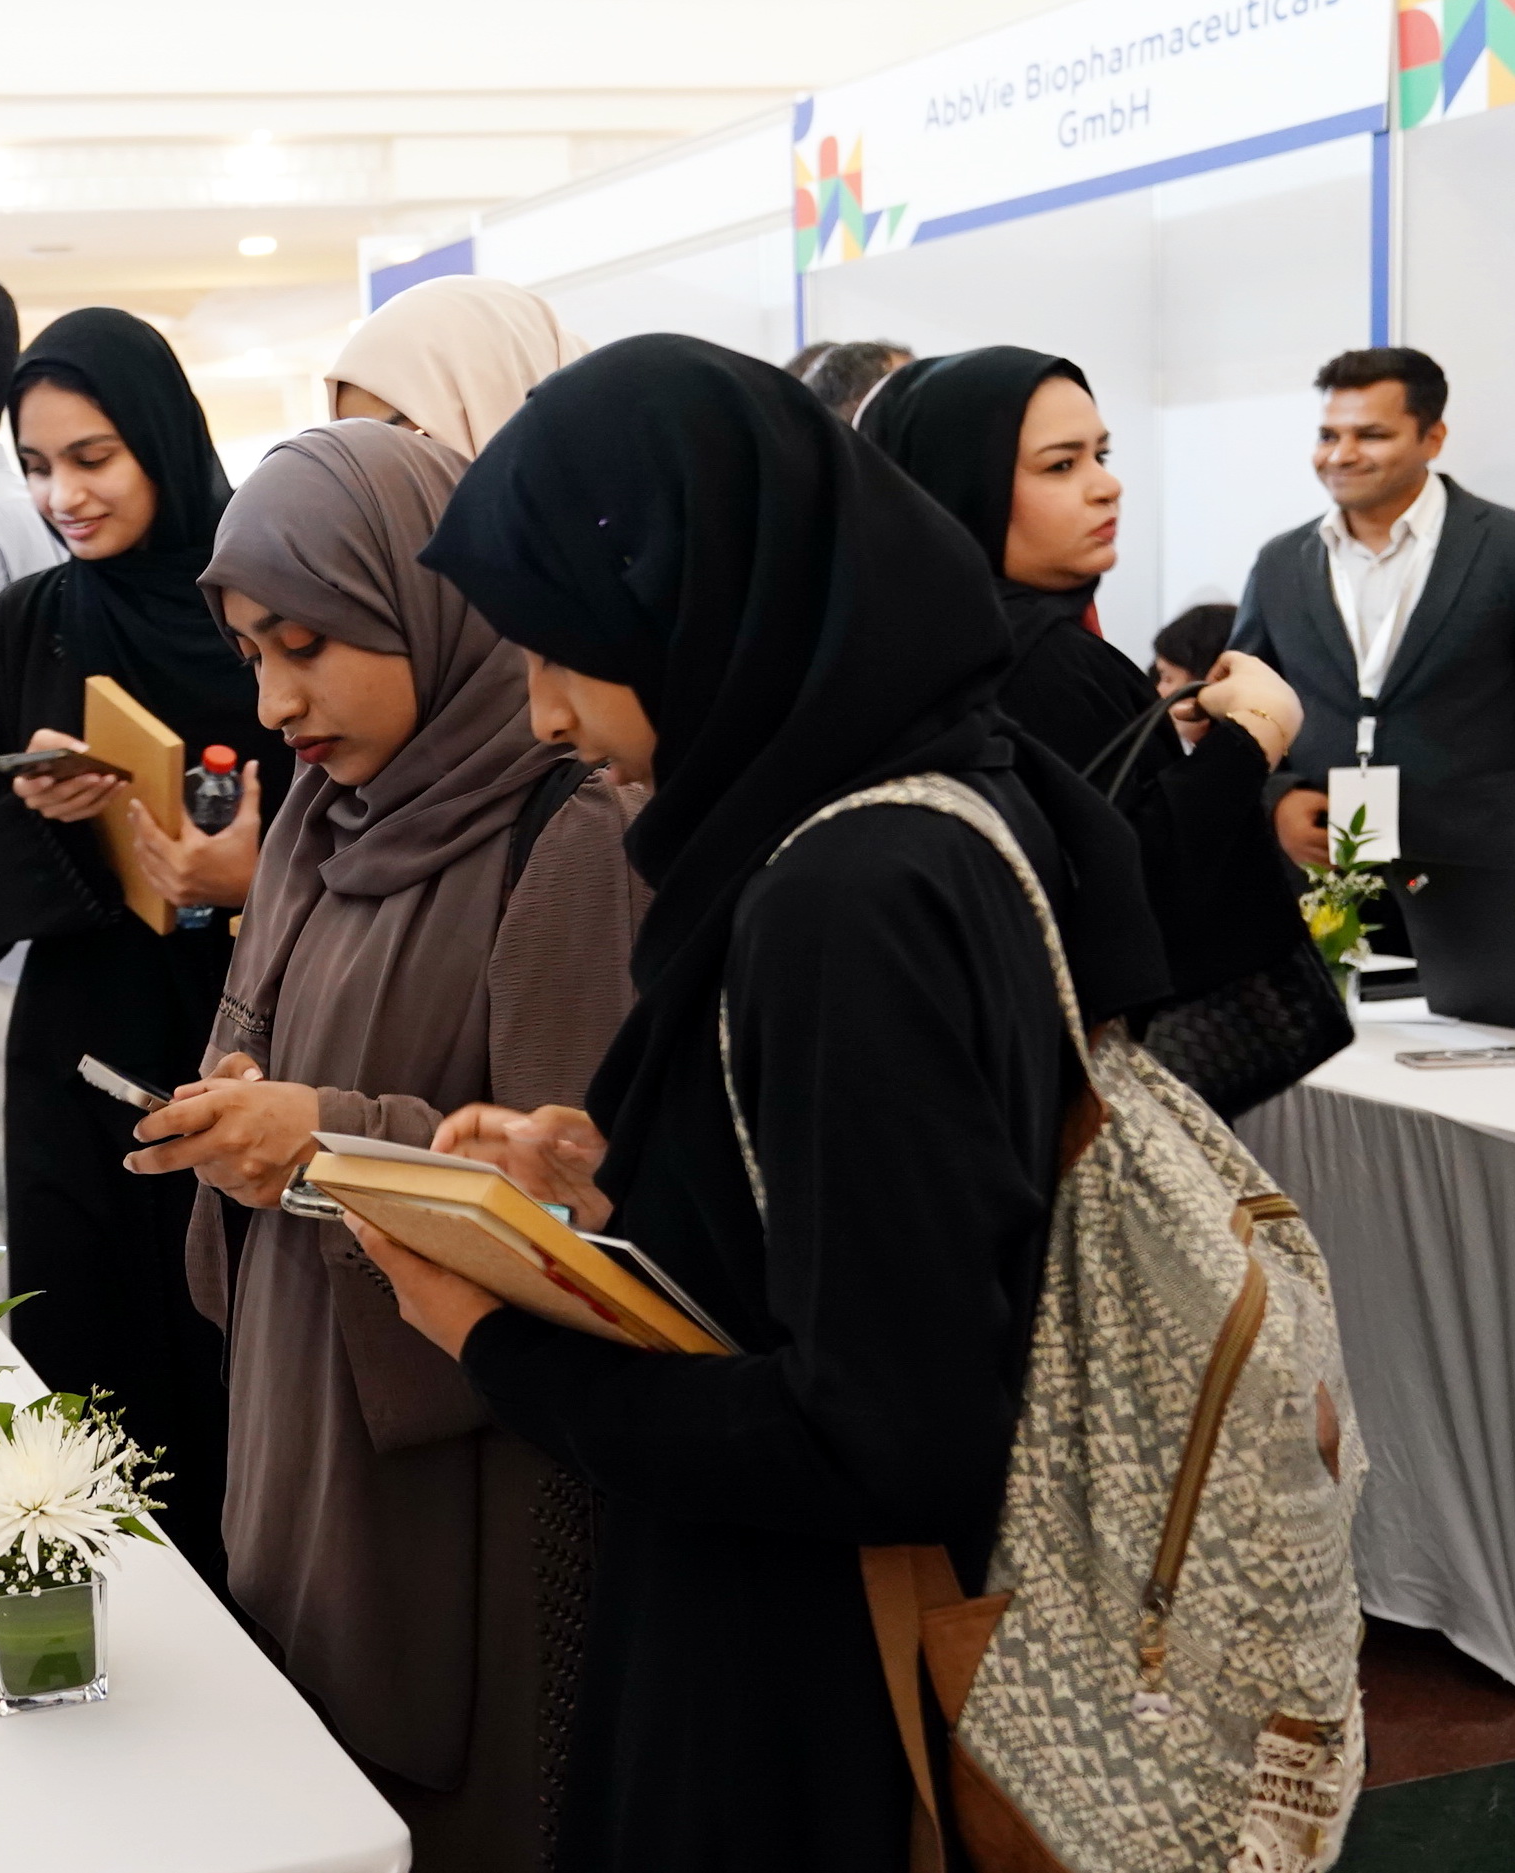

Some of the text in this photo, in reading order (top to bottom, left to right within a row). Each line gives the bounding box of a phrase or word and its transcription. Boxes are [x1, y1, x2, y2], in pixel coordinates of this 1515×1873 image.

[924, 0, 1339, 131] AbbVie Biopharmaceutica
[1058, 88, 1151, 148] GmbH
